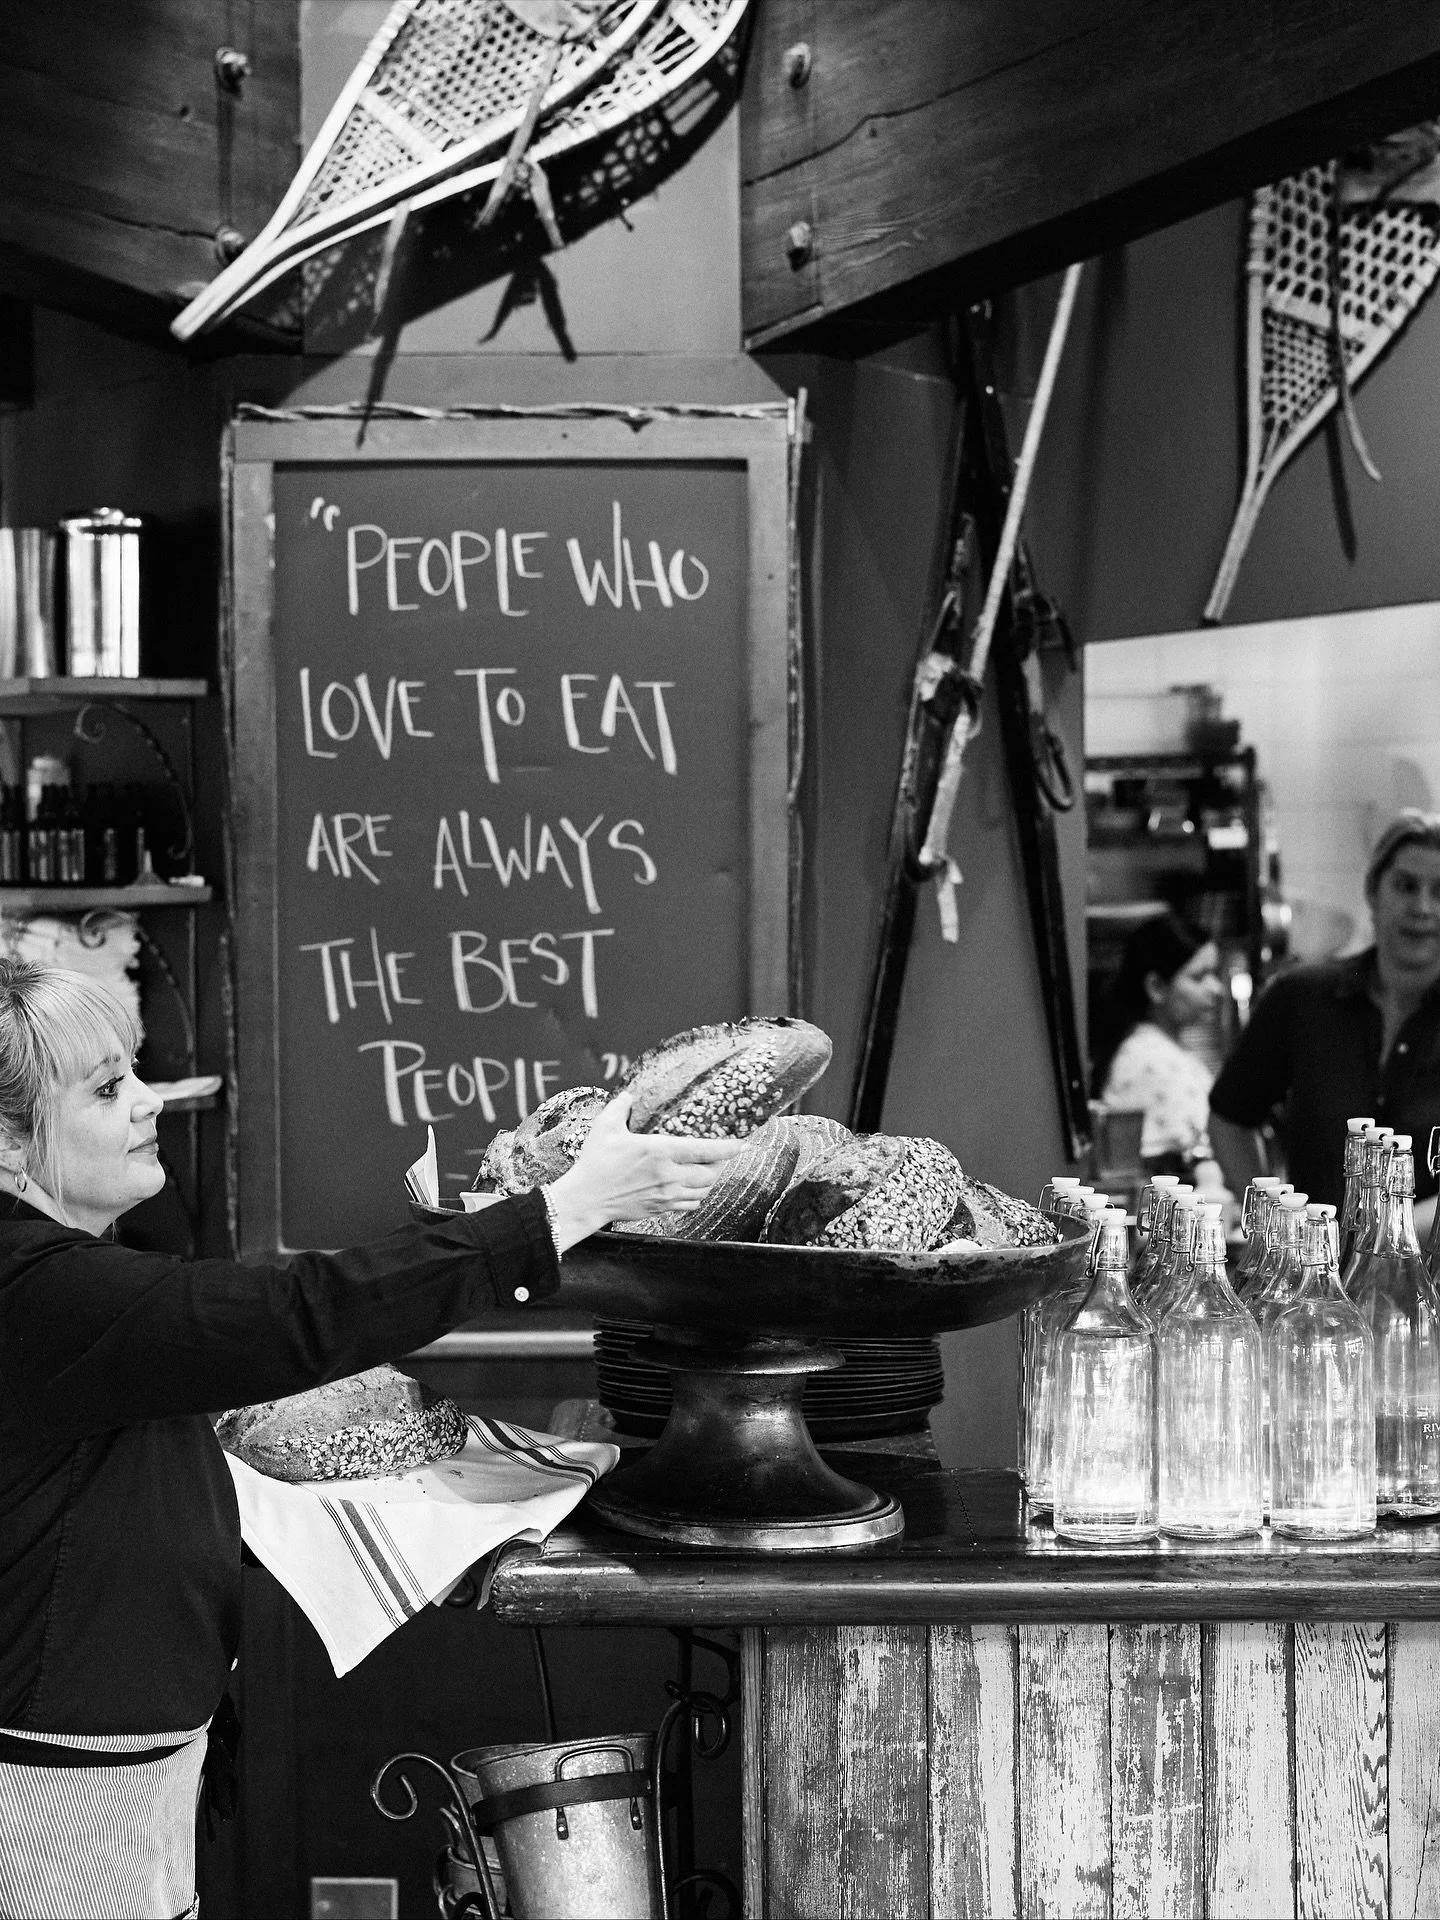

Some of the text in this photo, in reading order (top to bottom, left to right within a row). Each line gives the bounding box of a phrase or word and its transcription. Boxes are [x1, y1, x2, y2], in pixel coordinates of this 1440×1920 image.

[566, 500, 710, 612] WHO
[300, 667, 678, 783] LOVE TO EAT
[306, 809, 658, 914] ARE ALWAYS
[300, 927, 615, 1024] THE BEST
